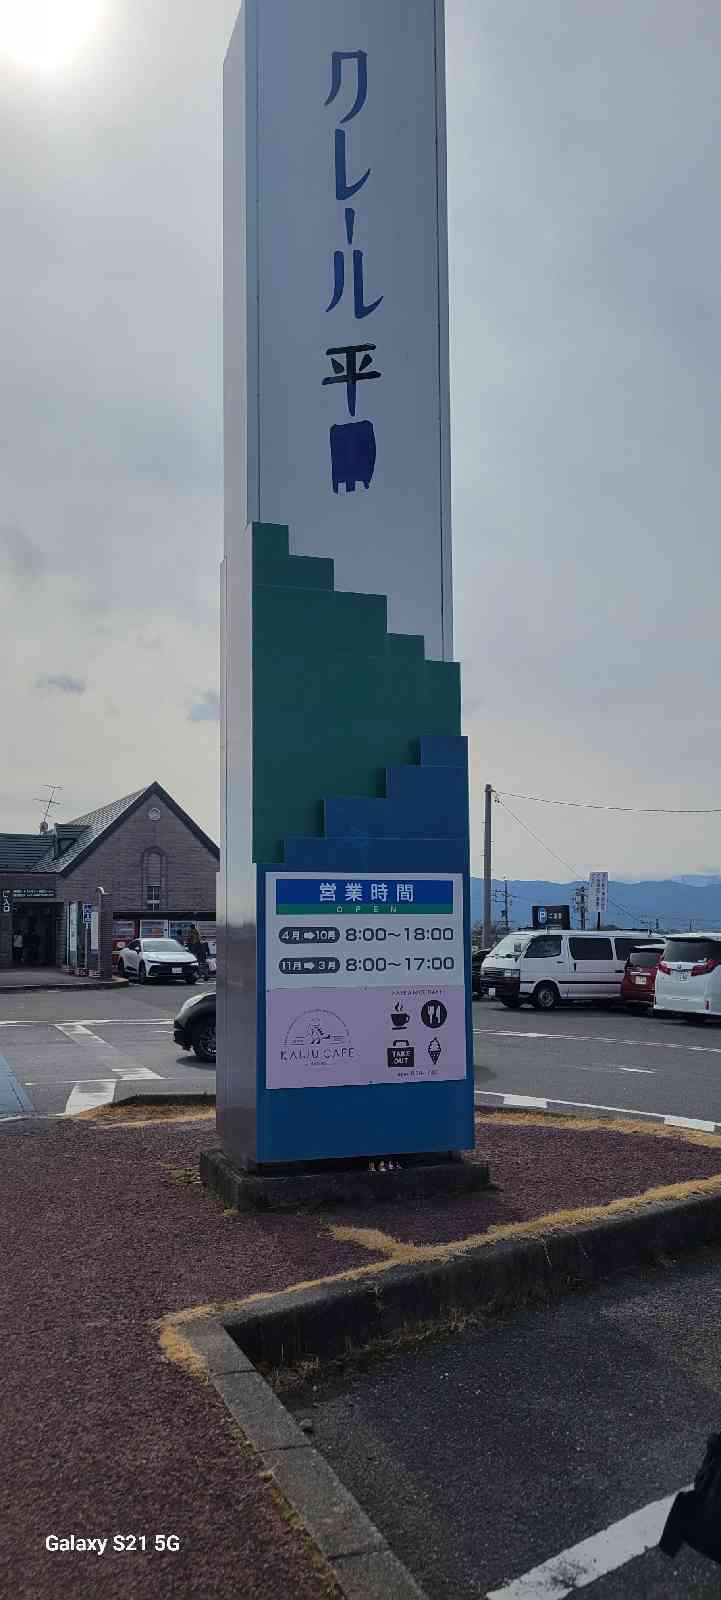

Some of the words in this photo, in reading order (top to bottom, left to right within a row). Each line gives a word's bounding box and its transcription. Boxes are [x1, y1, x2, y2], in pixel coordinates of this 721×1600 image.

[319, 882, 414, 902] 営業時間
[336, 905, 397, 913] OPEN
[281, 930, 300, 940] 4月
[316, 930, 337, 940] 10月
[281, 961, 301, 970] 11月
[318, 961, 337, 970] 3月
[391, 1050, 413, 1058] TAKE
[393, 1057, 409, 1065] OUT
